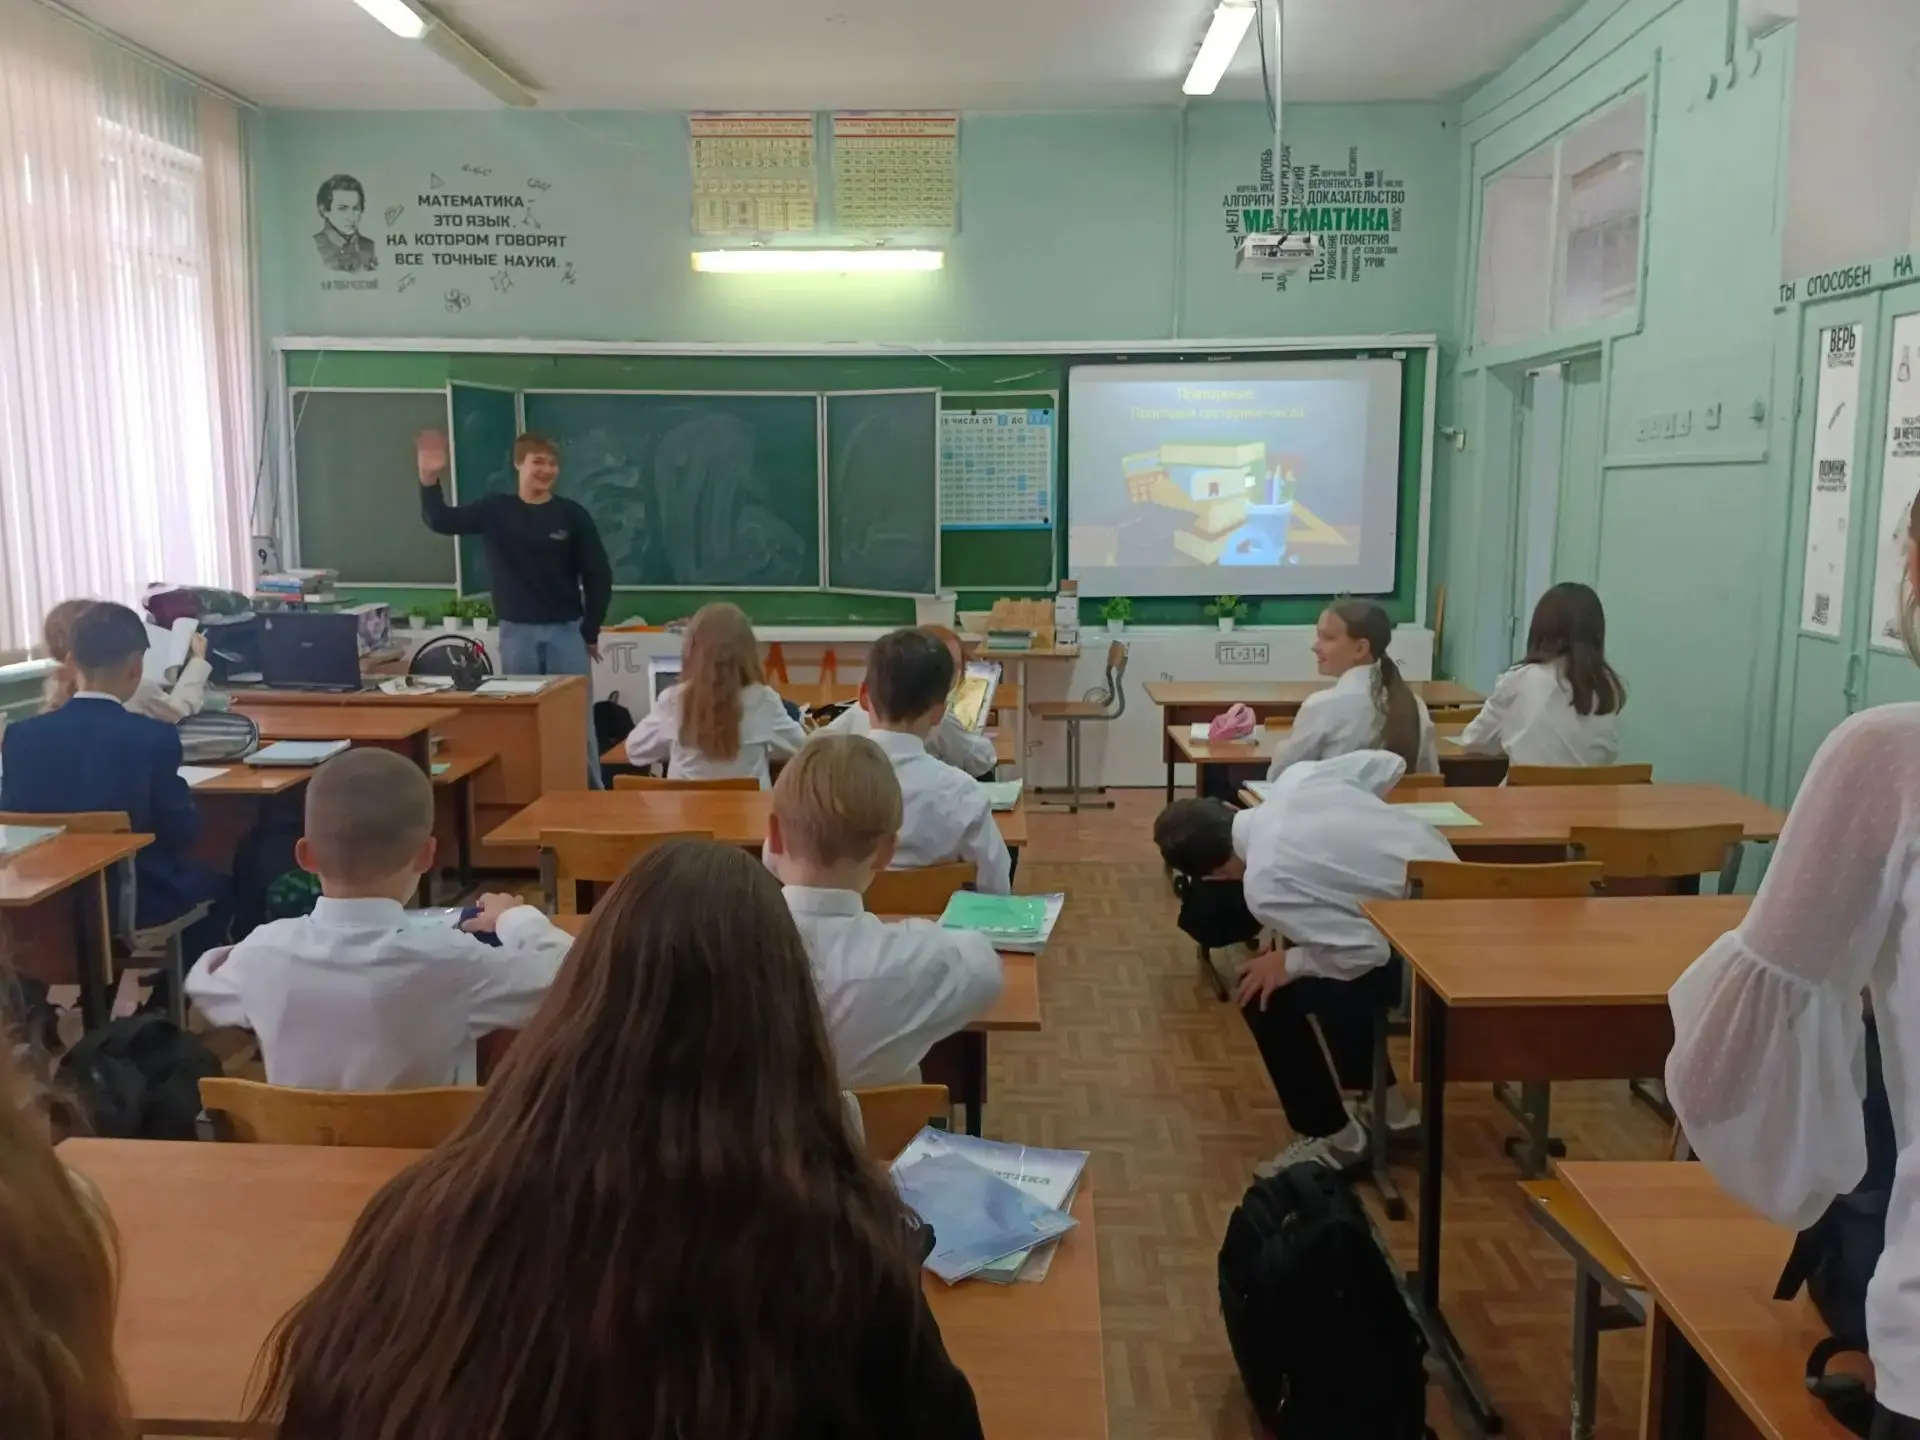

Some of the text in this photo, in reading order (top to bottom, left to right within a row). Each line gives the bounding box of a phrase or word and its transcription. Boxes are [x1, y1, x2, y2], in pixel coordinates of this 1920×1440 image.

[1308, 178, 1364, 189] ВЕРОЯТНОСТЬ
[418, 194, 524, 208] МАТЕМАТИКА
[1223, 194, 1275, 207] АЛГОРИТМ
[1307, 190, 1405, 205] ДОКАЗАТЕЛЬСТВО
[434, 214, 463, 228] ЭТО
[1226, 209, 1239, 233] МЕЛ
[1243, 207, 1390, 232] МАТЕМАТИКА
[387, 233, 567, 248] НА КОТОРОМ ГОВОРЯТ
[1340, 234, 1389, 245] ГЕОМЕТРИЯ
[395, 253, 423, 266] ВСЕ
[432, 253, 498, 266] ТОЧНЫЕ
[1327, 234, 1337, 280] УРАВНЕНИЕ
[1779, 254, 1913, 303] ТЫ СПОСОБЕН НА
[1830, 326, 1856, 352] ВЕРЬ
[953, 417, 980, 425] ЧИСЛА
[982, 417, 993, 425] ОТ
[1011, 417, 1023, 426] ДО
